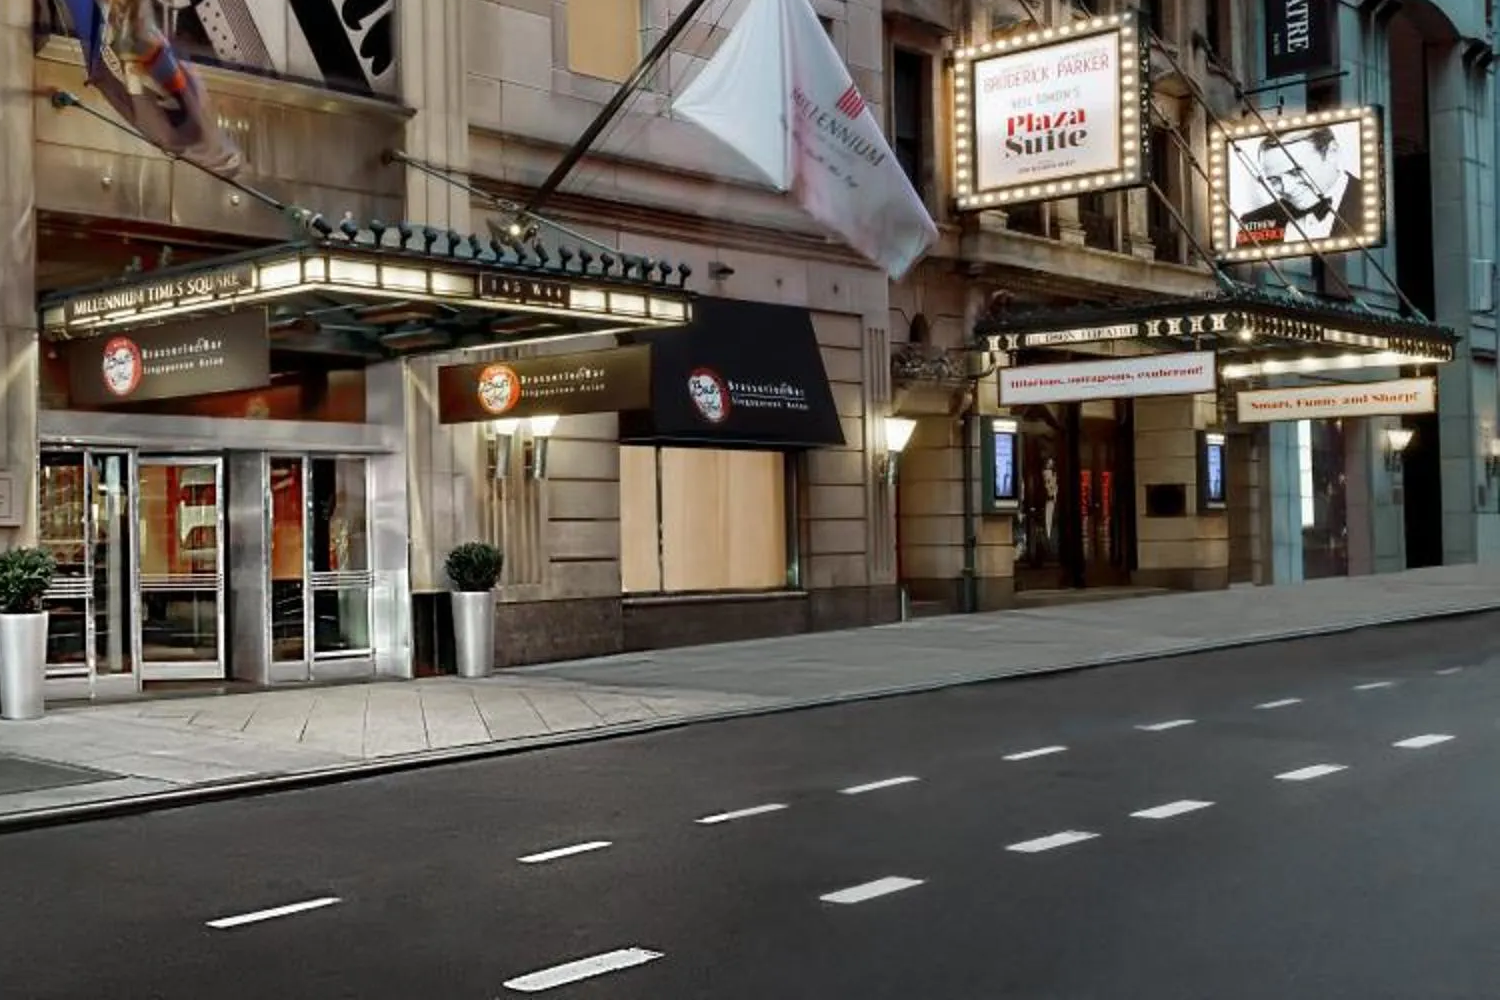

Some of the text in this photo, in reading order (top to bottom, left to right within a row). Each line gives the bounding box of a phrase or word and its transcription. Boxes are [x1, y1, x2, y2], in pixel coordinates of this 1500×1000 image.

[1057, 53, 1109, 79] PARKER
[1006, 108, 1086, 137] Plaza
[1004, 128, 1088, 158] Suite
[73, 291, 144, 315] MILLENNIUM
[147, 282, 184, 302] TIMES
[1341, 394, 1368, 405] and
